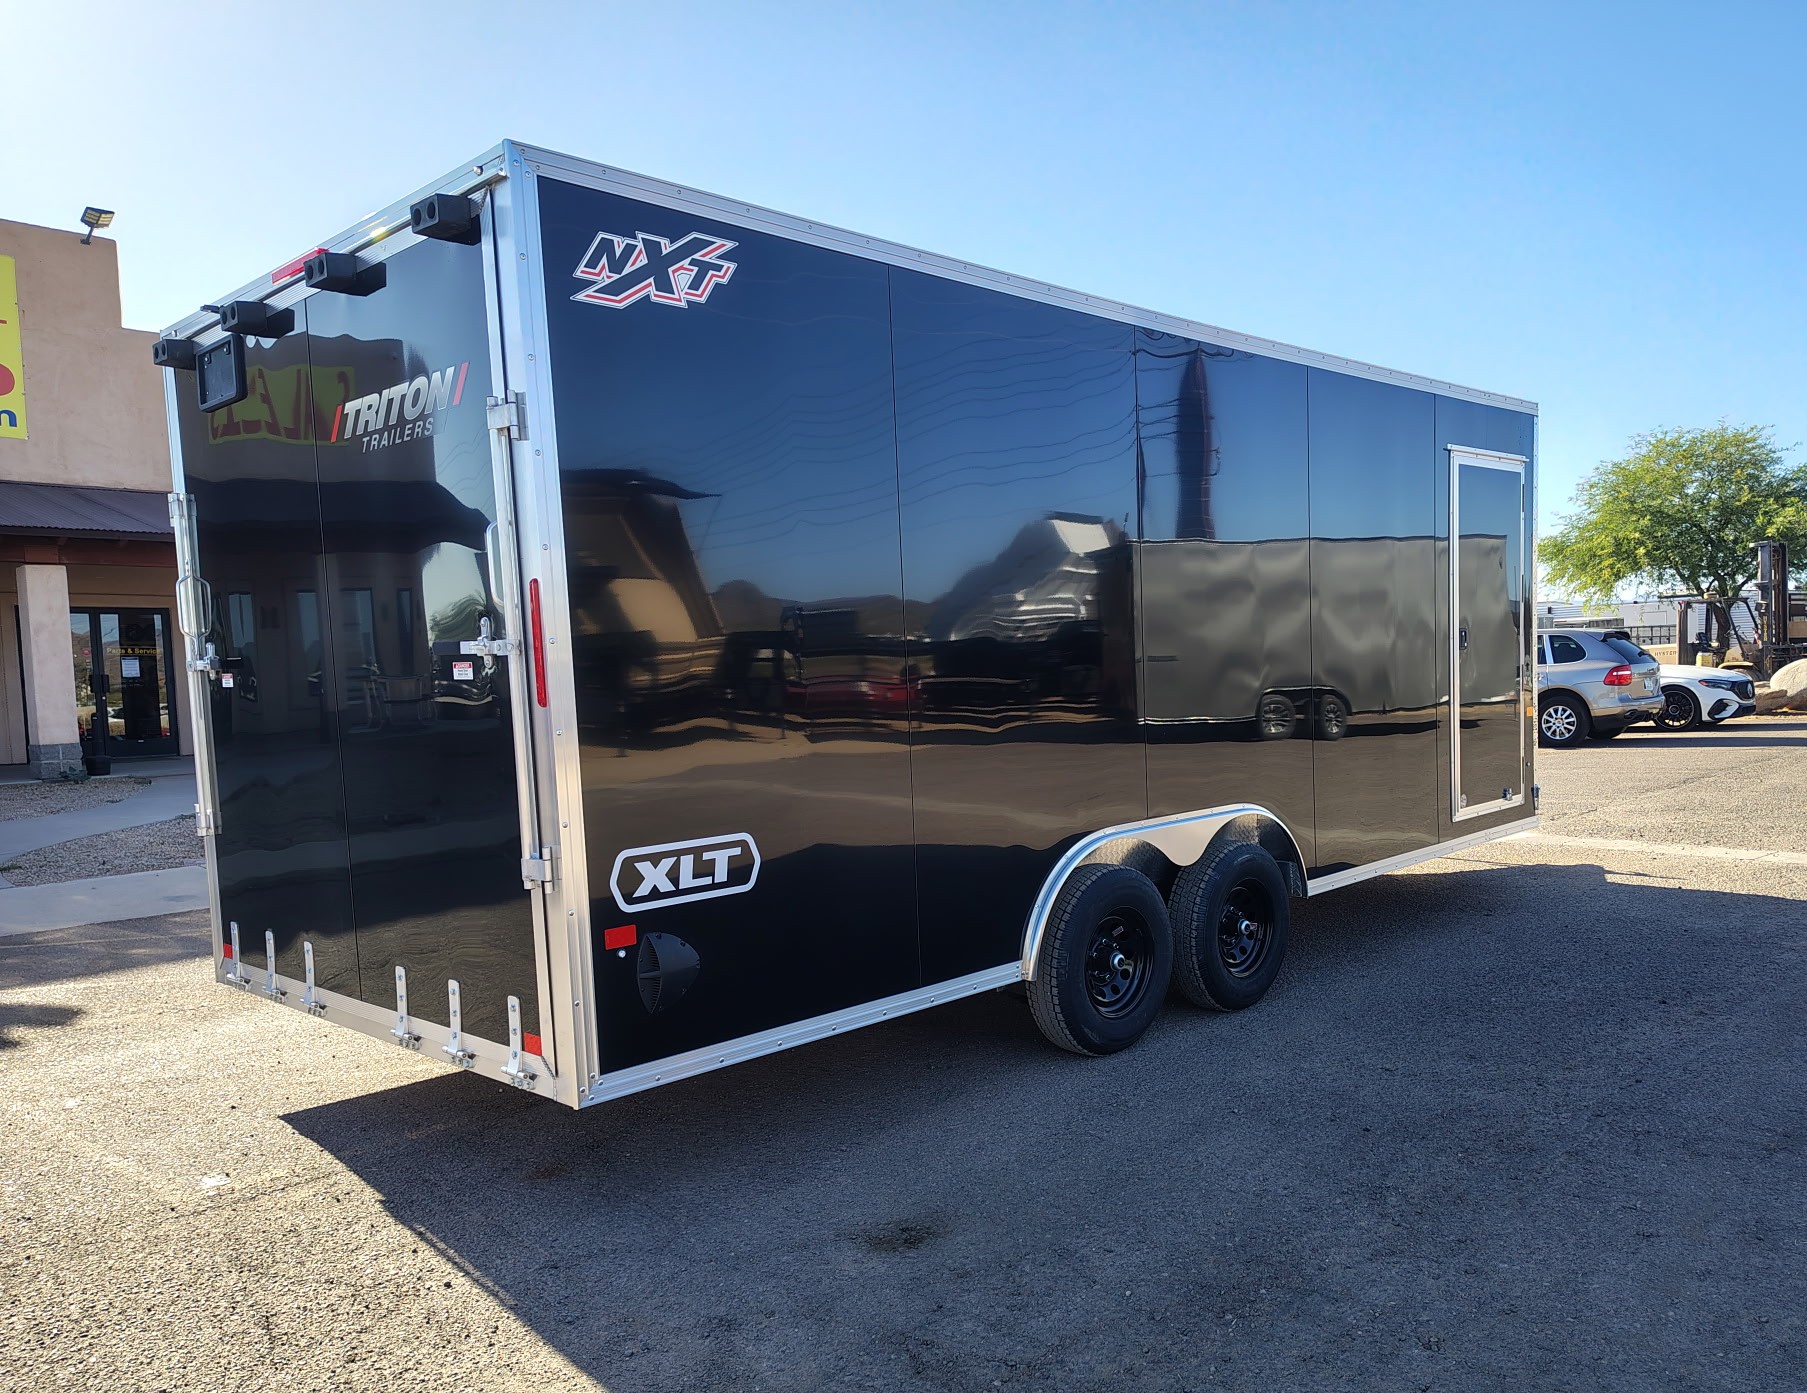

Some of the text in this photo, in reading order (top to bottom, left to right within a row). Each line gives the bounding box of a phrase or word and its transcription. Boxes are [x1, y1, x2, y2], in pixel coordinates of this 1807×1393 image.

[570, 231, 739, 310] NXT
[343, 365, 455, 440] TRITON
[361, 417, 434, 454] TRAILERS
[127, 647, 133, 655] &
[632, 846, 743, 898] XLT
